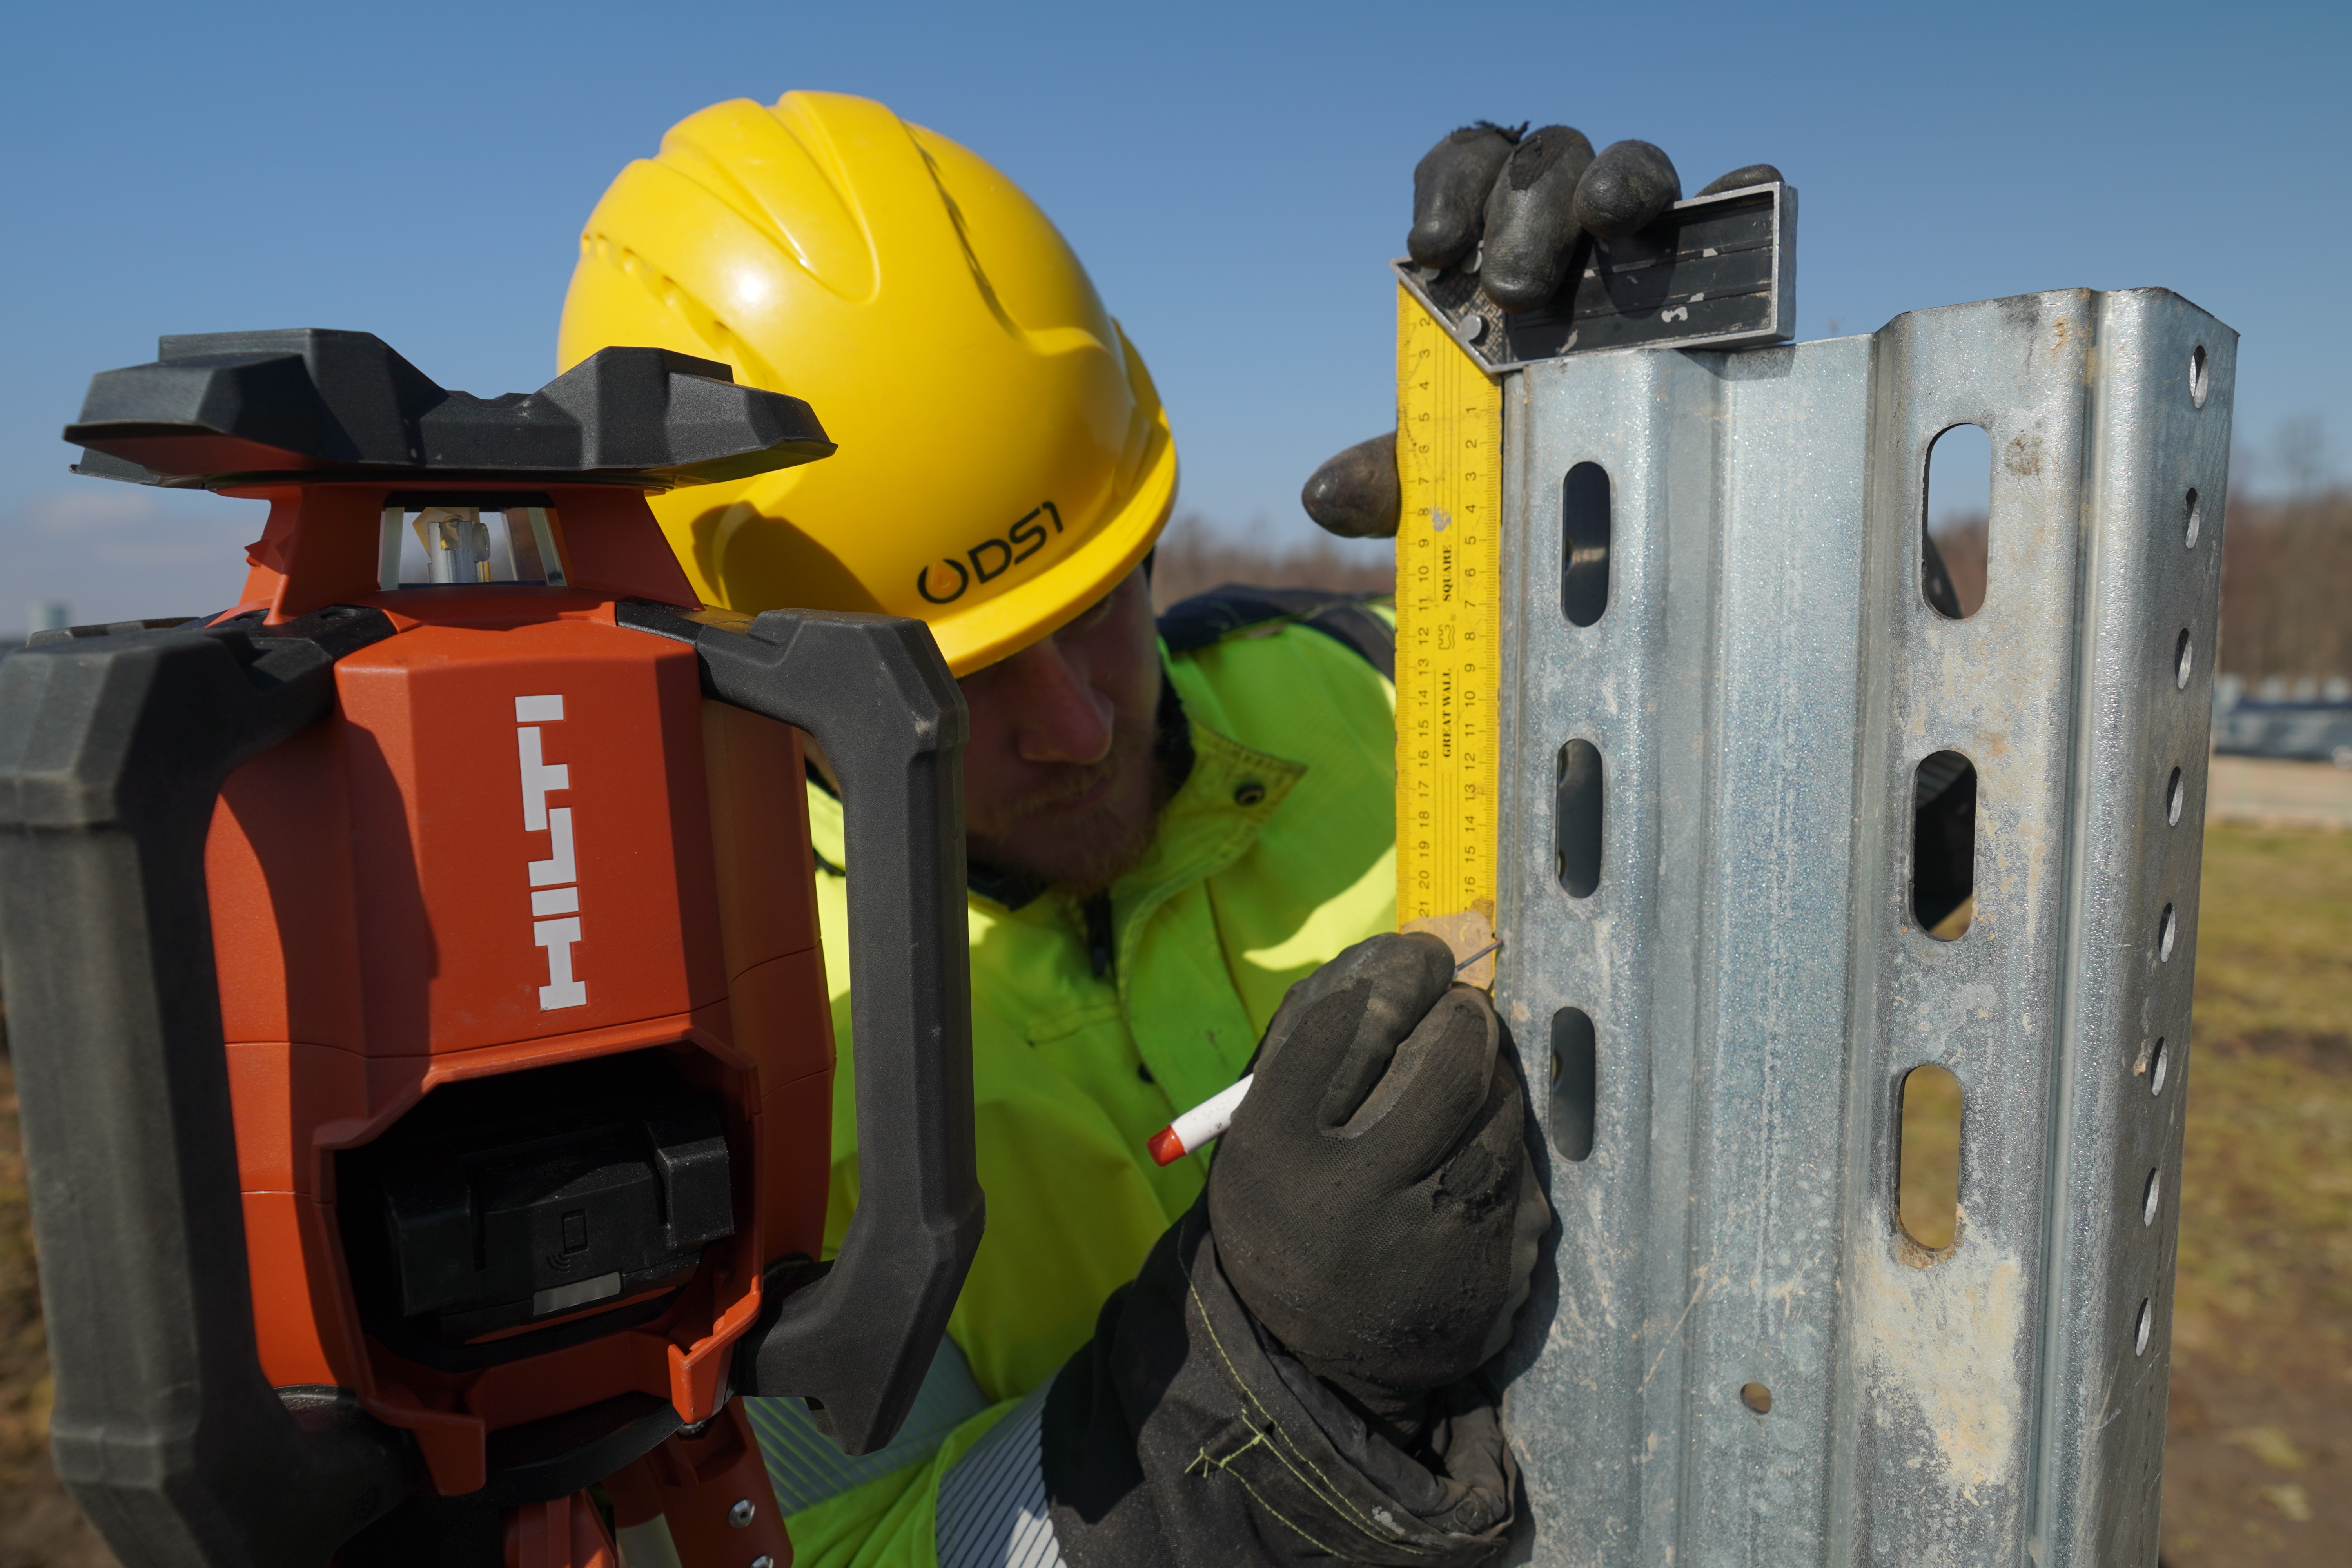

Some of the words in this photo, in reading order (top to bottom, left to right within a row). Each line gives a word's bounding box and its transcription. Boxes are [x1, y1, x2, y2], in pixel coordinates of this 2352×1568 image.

[1420, 349, 1430, 358] 3
[1420, 381, 1429, 390] 4
[1419, 413, 1429, 421] 5
[1419, 445, 1429, 453] 6
[1466, 439, 1477, 448] 2
[1466, 472, 1476, 481] 3
[1419, 508, 1429, 516] 8
[1466, 504, 1476, 513] 4
[1419, 539, 1429, 548] 9
[1466, 536, 1476, 545] 5
[1419, 566, 1428, 582] 10
[1443, 544, 1453, 602] SQUARE
[1466, 568, 1476, 577] 6
[1420, 598, 1428, 611] 11
[1465, 600, 1475, 608] 7
[1419, 628, 1428, 645] 12
[1465, 632, 1475, 641] 8
[1419, 659, 1428, 676] 13
[1443, 668, 1451, 707] WALL
[1419, 690, 1428, 706] 14
[1465, 691, 1475, 707] 10
[1419, 720, 1428, 737] 15
[1443, 710, 1451, 758] GREAT
[1466, 723, 1475, 737] 11
[1419, 750, 1429, 768] 16
[1465, 753, 1475, 770] 12
[1419, 781, 1428, 798] 17
[1465, 784, 1475, 801] 13
[1419, 811, 1429, 828] 18
[1466, 816, 1475, 832] 14
[515, 694, 587, 1012] HILTI
[1419, 841, 1429, 858] 19
[1465, 846, 1475, 863] 15
[1419, 871, 1429, 889] 20
[1465, 877, 1475, 893] 16
[1419, 901, 1429, 917] 21
